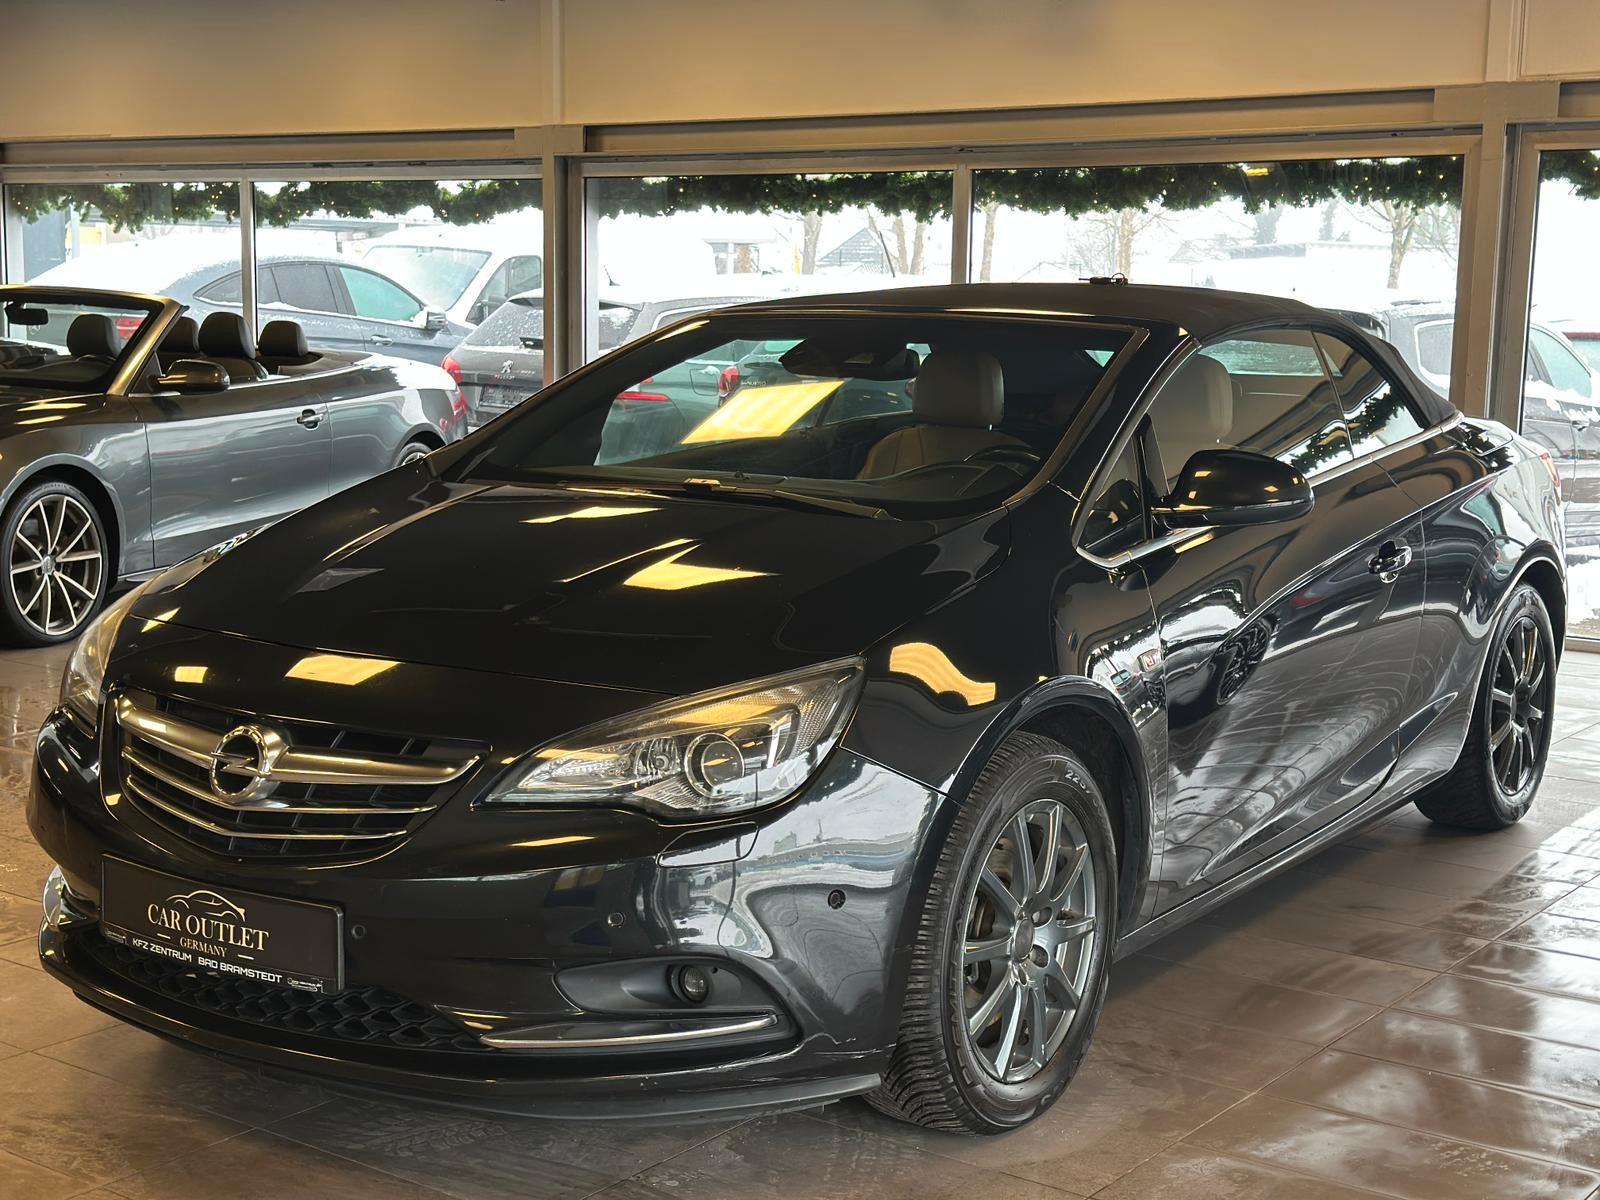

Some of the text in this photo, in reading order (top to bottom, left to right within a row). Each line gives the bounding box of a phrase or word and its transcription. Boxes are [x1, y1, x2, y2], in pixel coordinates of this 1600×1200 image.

[147, 903, 270, 951] CAR OUTLET
[180, 936, 228, 958] GERMANY
[132, 937, 283, 983] KFZ ZENTRUM BAD BRAMSTEDT
